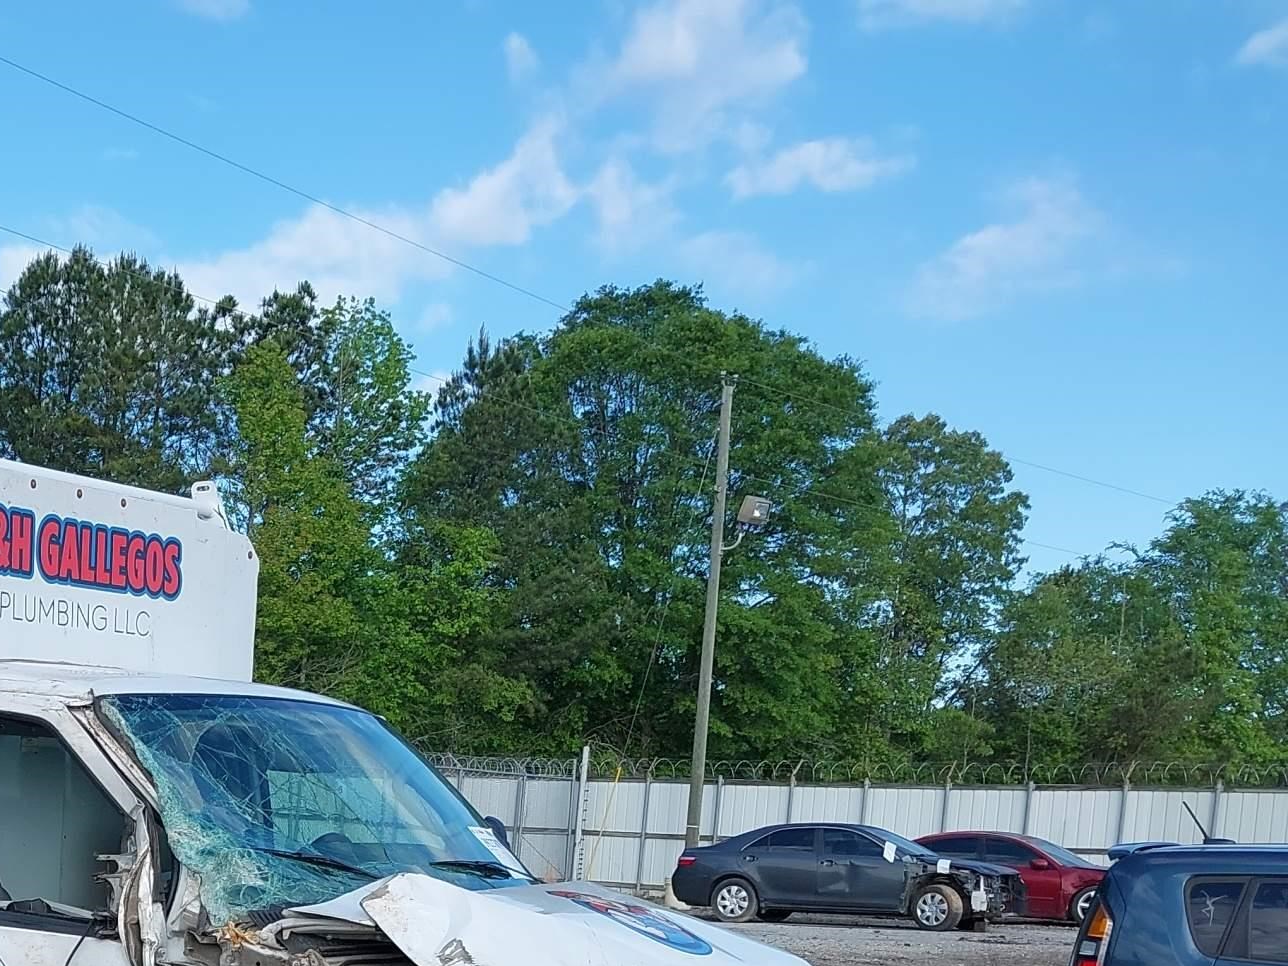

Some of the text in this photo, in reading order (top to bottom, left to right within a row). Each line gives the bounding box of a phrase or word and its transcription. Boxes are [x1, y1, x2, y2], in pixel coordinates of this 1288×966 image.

[38, 516, 182, 598] GALLEGOS
[0, 592, 150, 636] PLUMBING LLC
